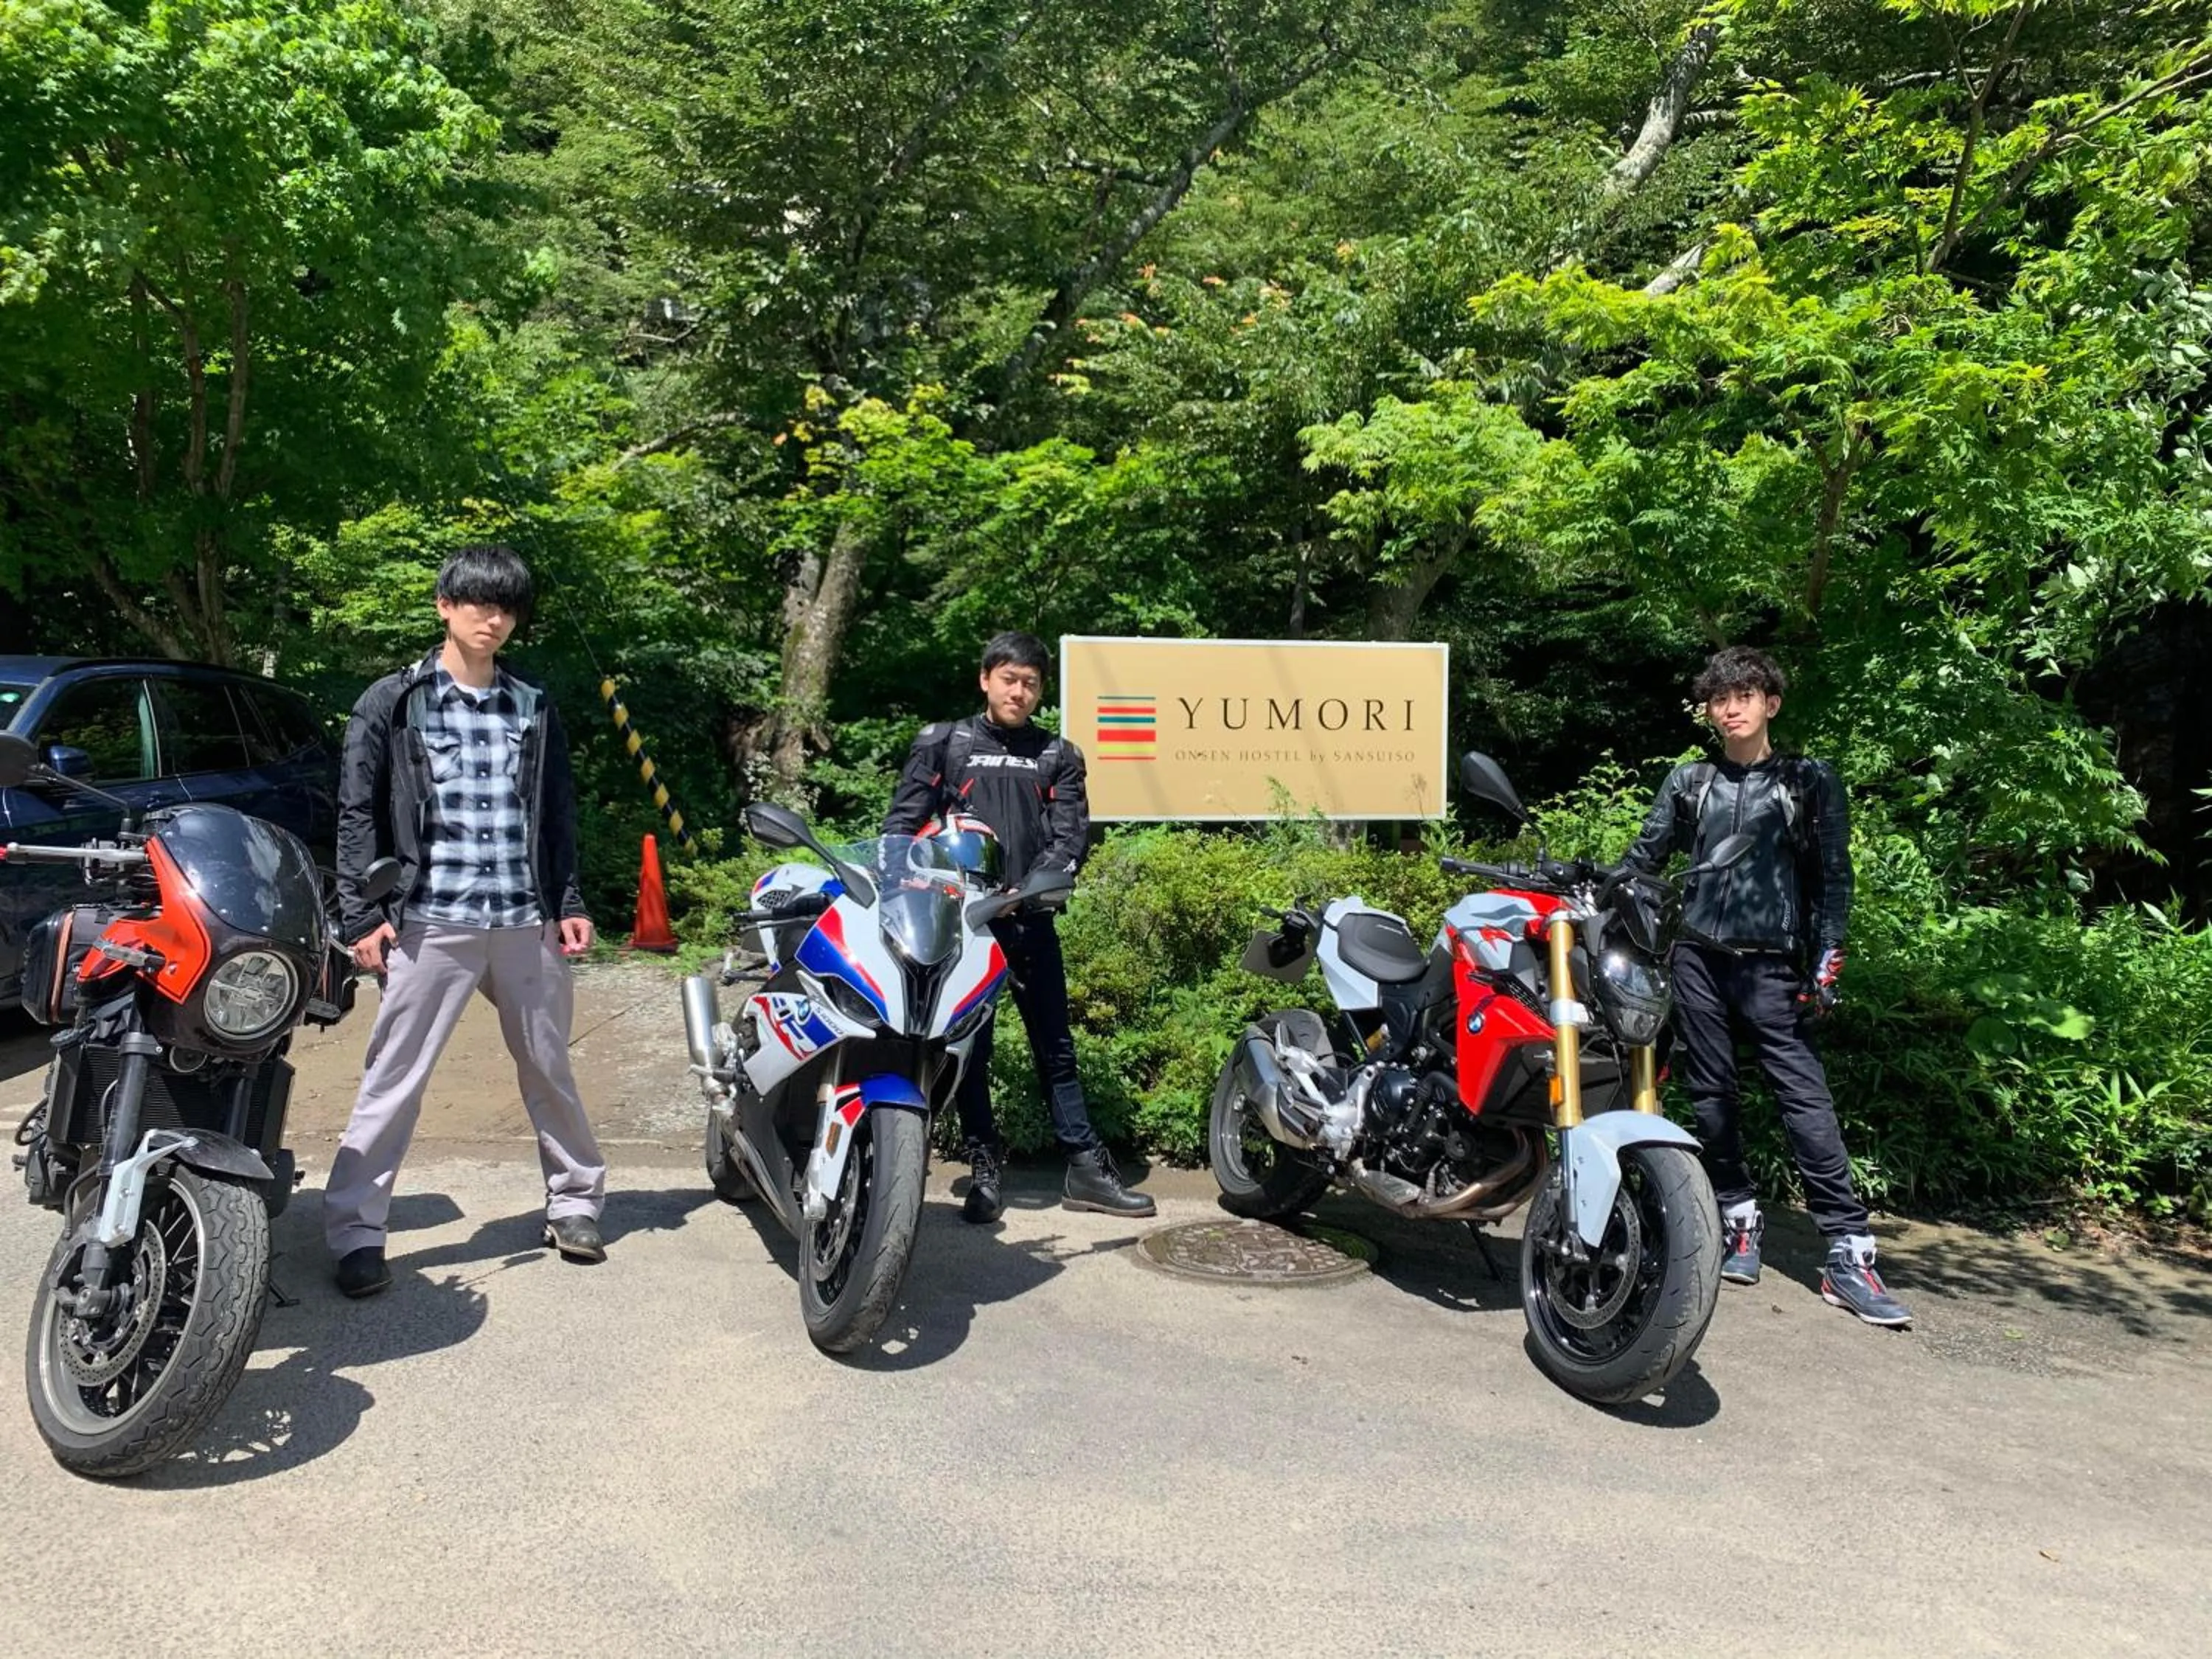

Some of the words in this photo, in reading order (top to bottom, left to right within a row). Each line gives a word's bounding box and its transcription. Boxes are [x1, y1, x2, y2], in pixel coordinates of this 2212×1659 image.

[1178, 697, 1415, 731] YUMORI
[1175, 748, 1230, 761] ONSEN
[1239, 749, 1303, 761] HOSTEL
[1310, 749, 1326, 764] by
[1333, 749, 1416, 762] SANSUISO
